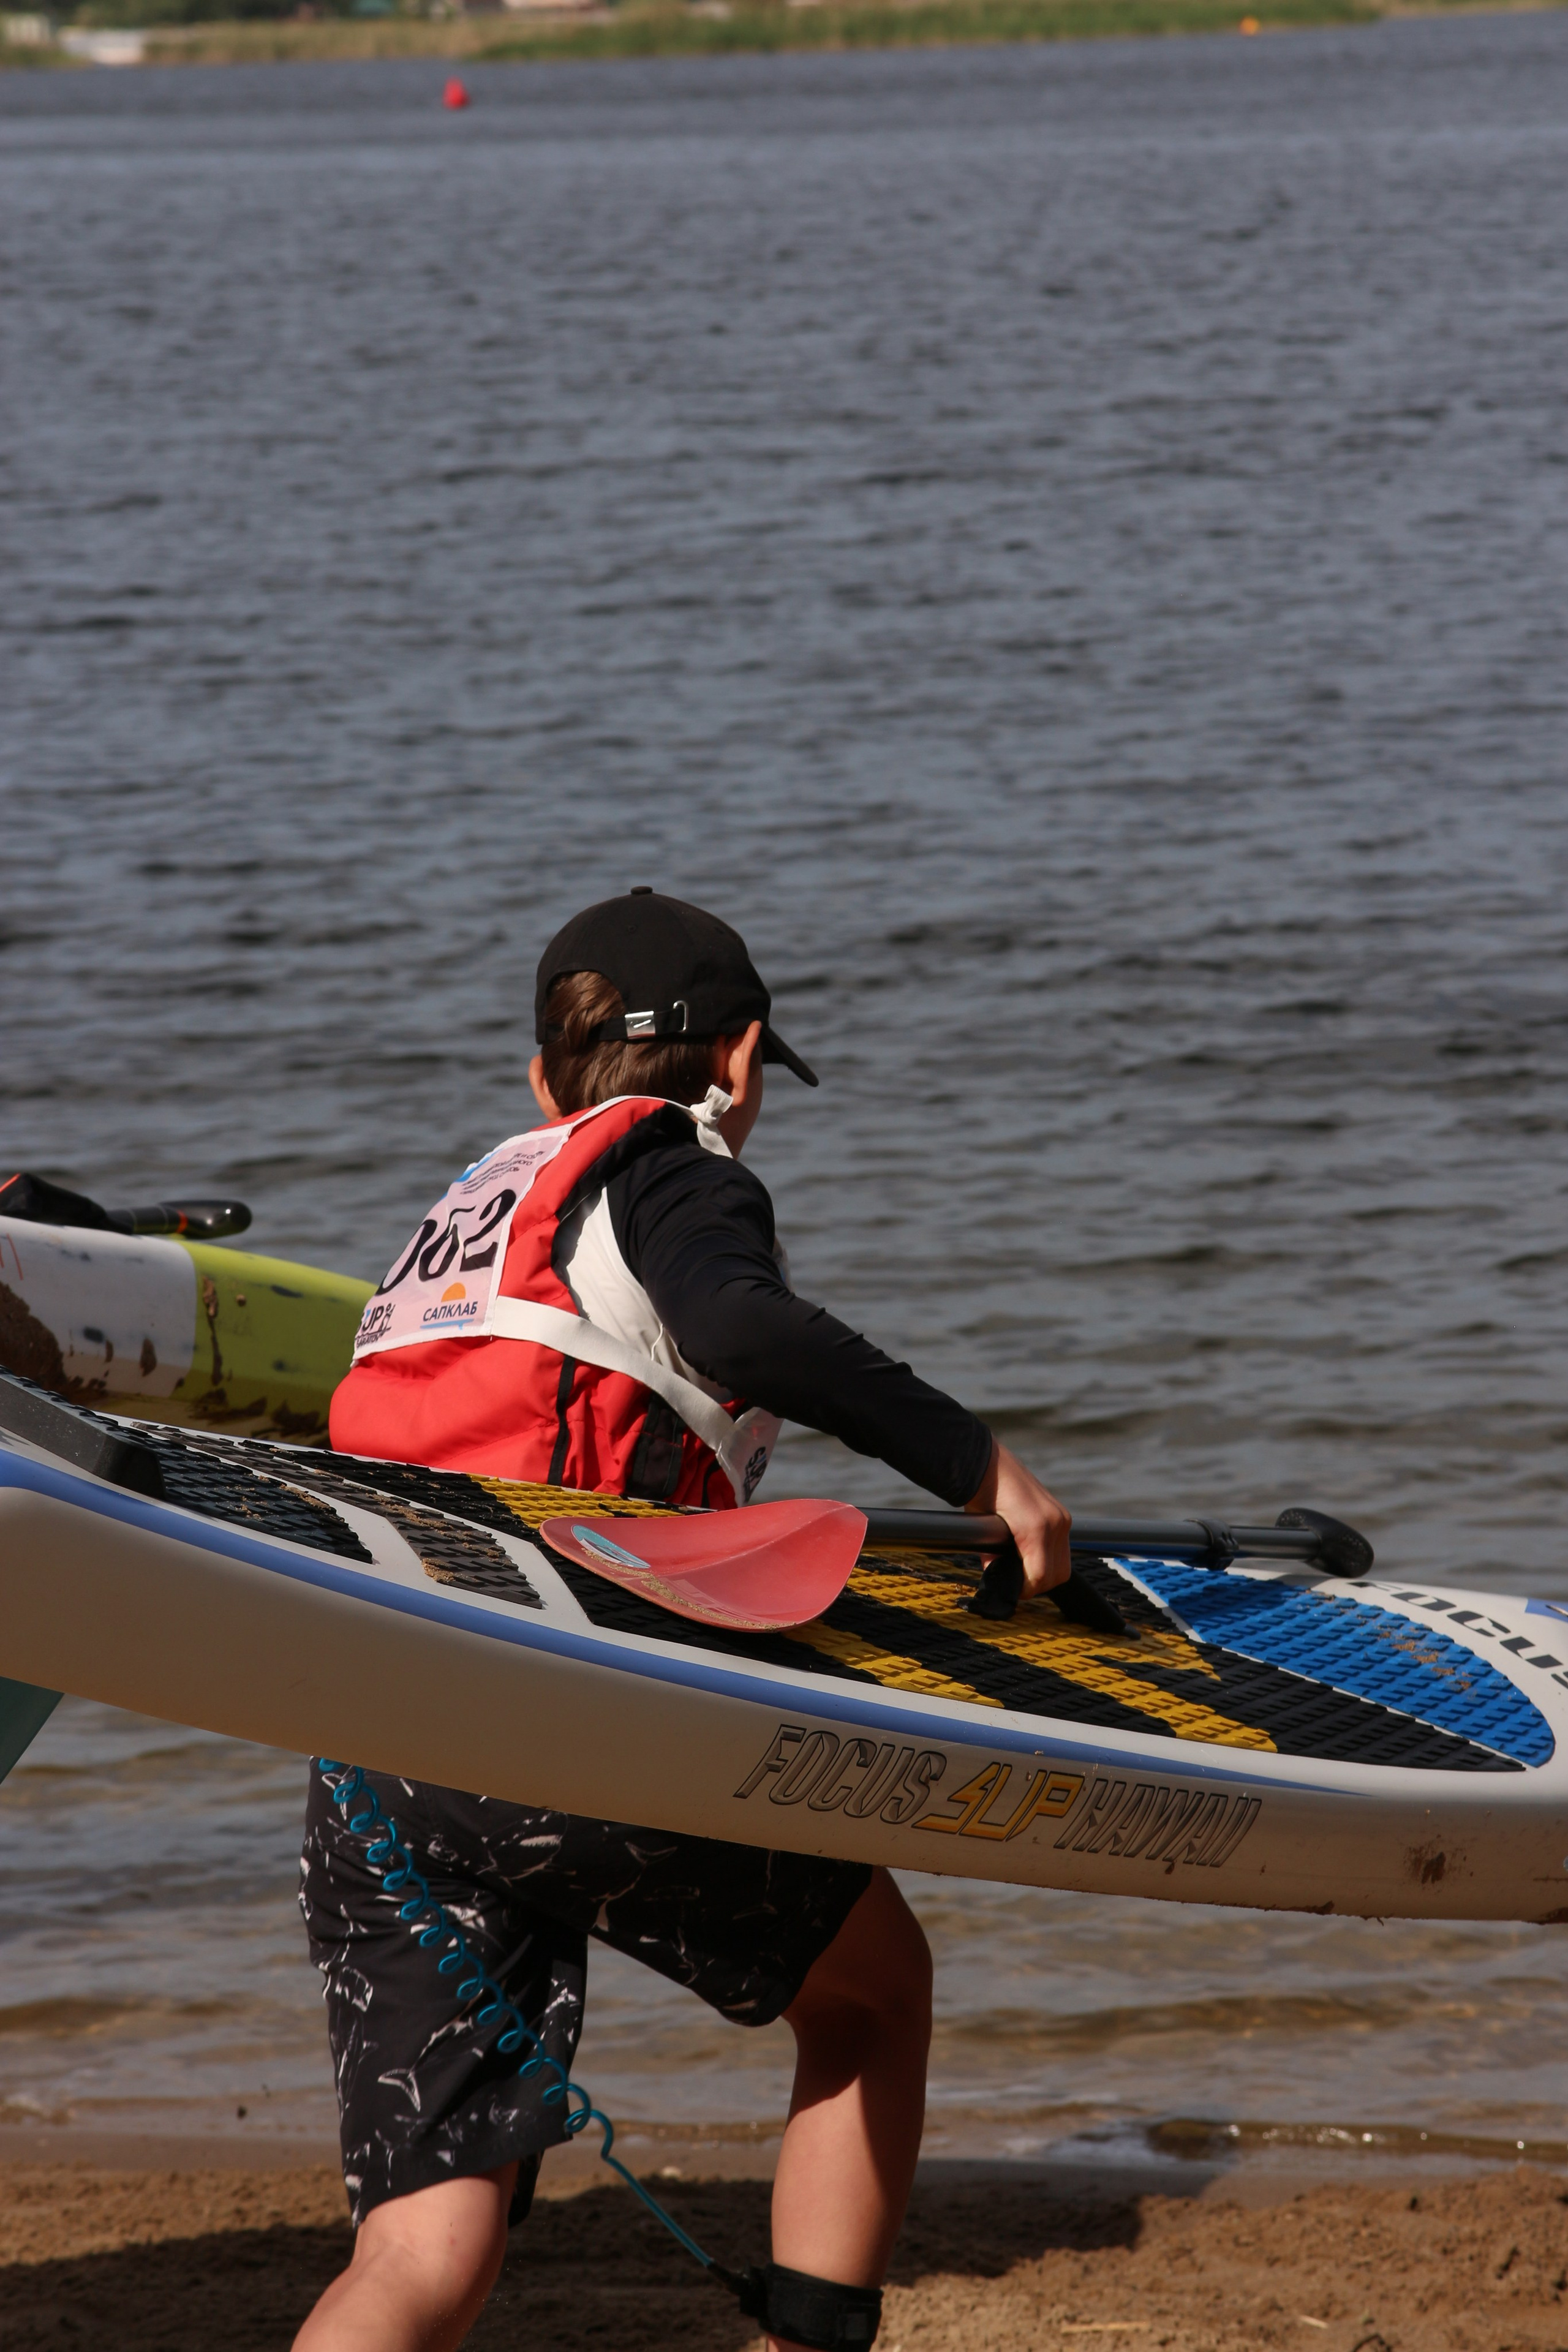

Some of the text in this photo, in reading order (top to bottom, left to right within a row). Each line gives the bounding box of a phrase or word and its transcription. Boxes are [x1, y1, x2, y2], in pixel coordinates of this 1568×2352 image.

[375, 1189, 516, 1296] 062
[423, 1302, 478, 1322] САПКЛАБ
[733, 1724, 1262, 1867] FOCUS SUP HAWAII
